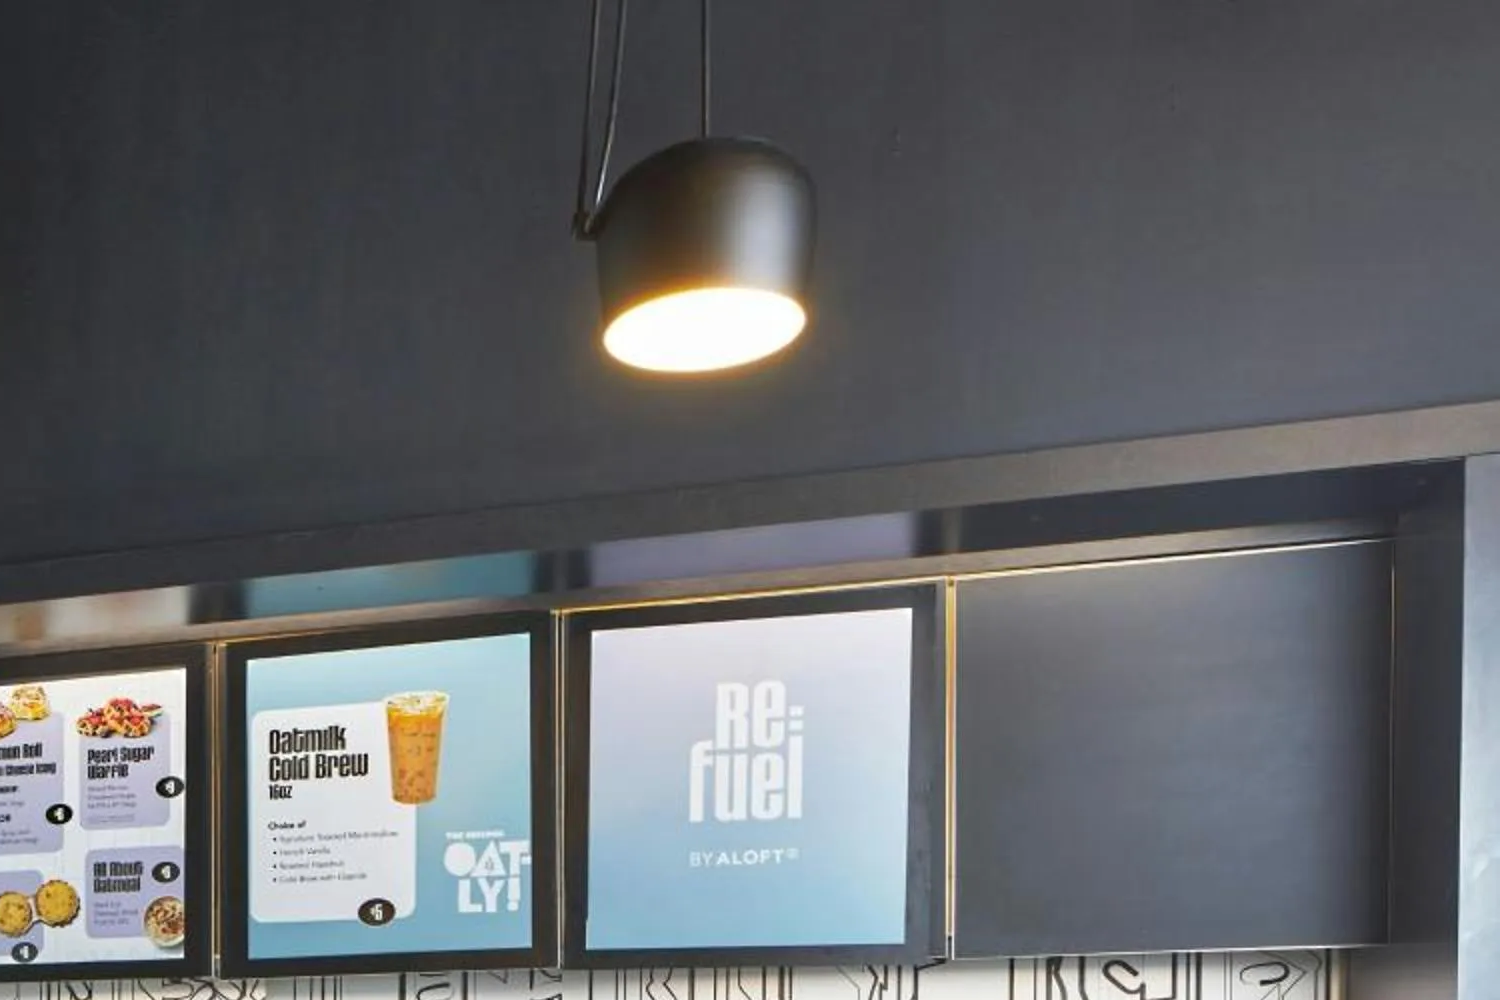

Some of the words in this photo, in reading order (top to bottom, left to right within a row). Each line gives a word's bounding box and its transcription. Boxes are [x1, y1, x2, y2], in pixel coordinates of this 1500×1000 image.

[269, 726, 346, 754] Oatmilk
[22, 742, 43, 759] Roll
[88, 747, 118, 764] Pearl
[120, 746, 154, 762] Sugar
[269, 755, 309, 782] Cold
[315, 753, 369, 780] Brew
[689, 735, 804, 823] fuel
[269, 785, 293, 800] 16oz
[94, 876, 141, 894] Oatmeal
